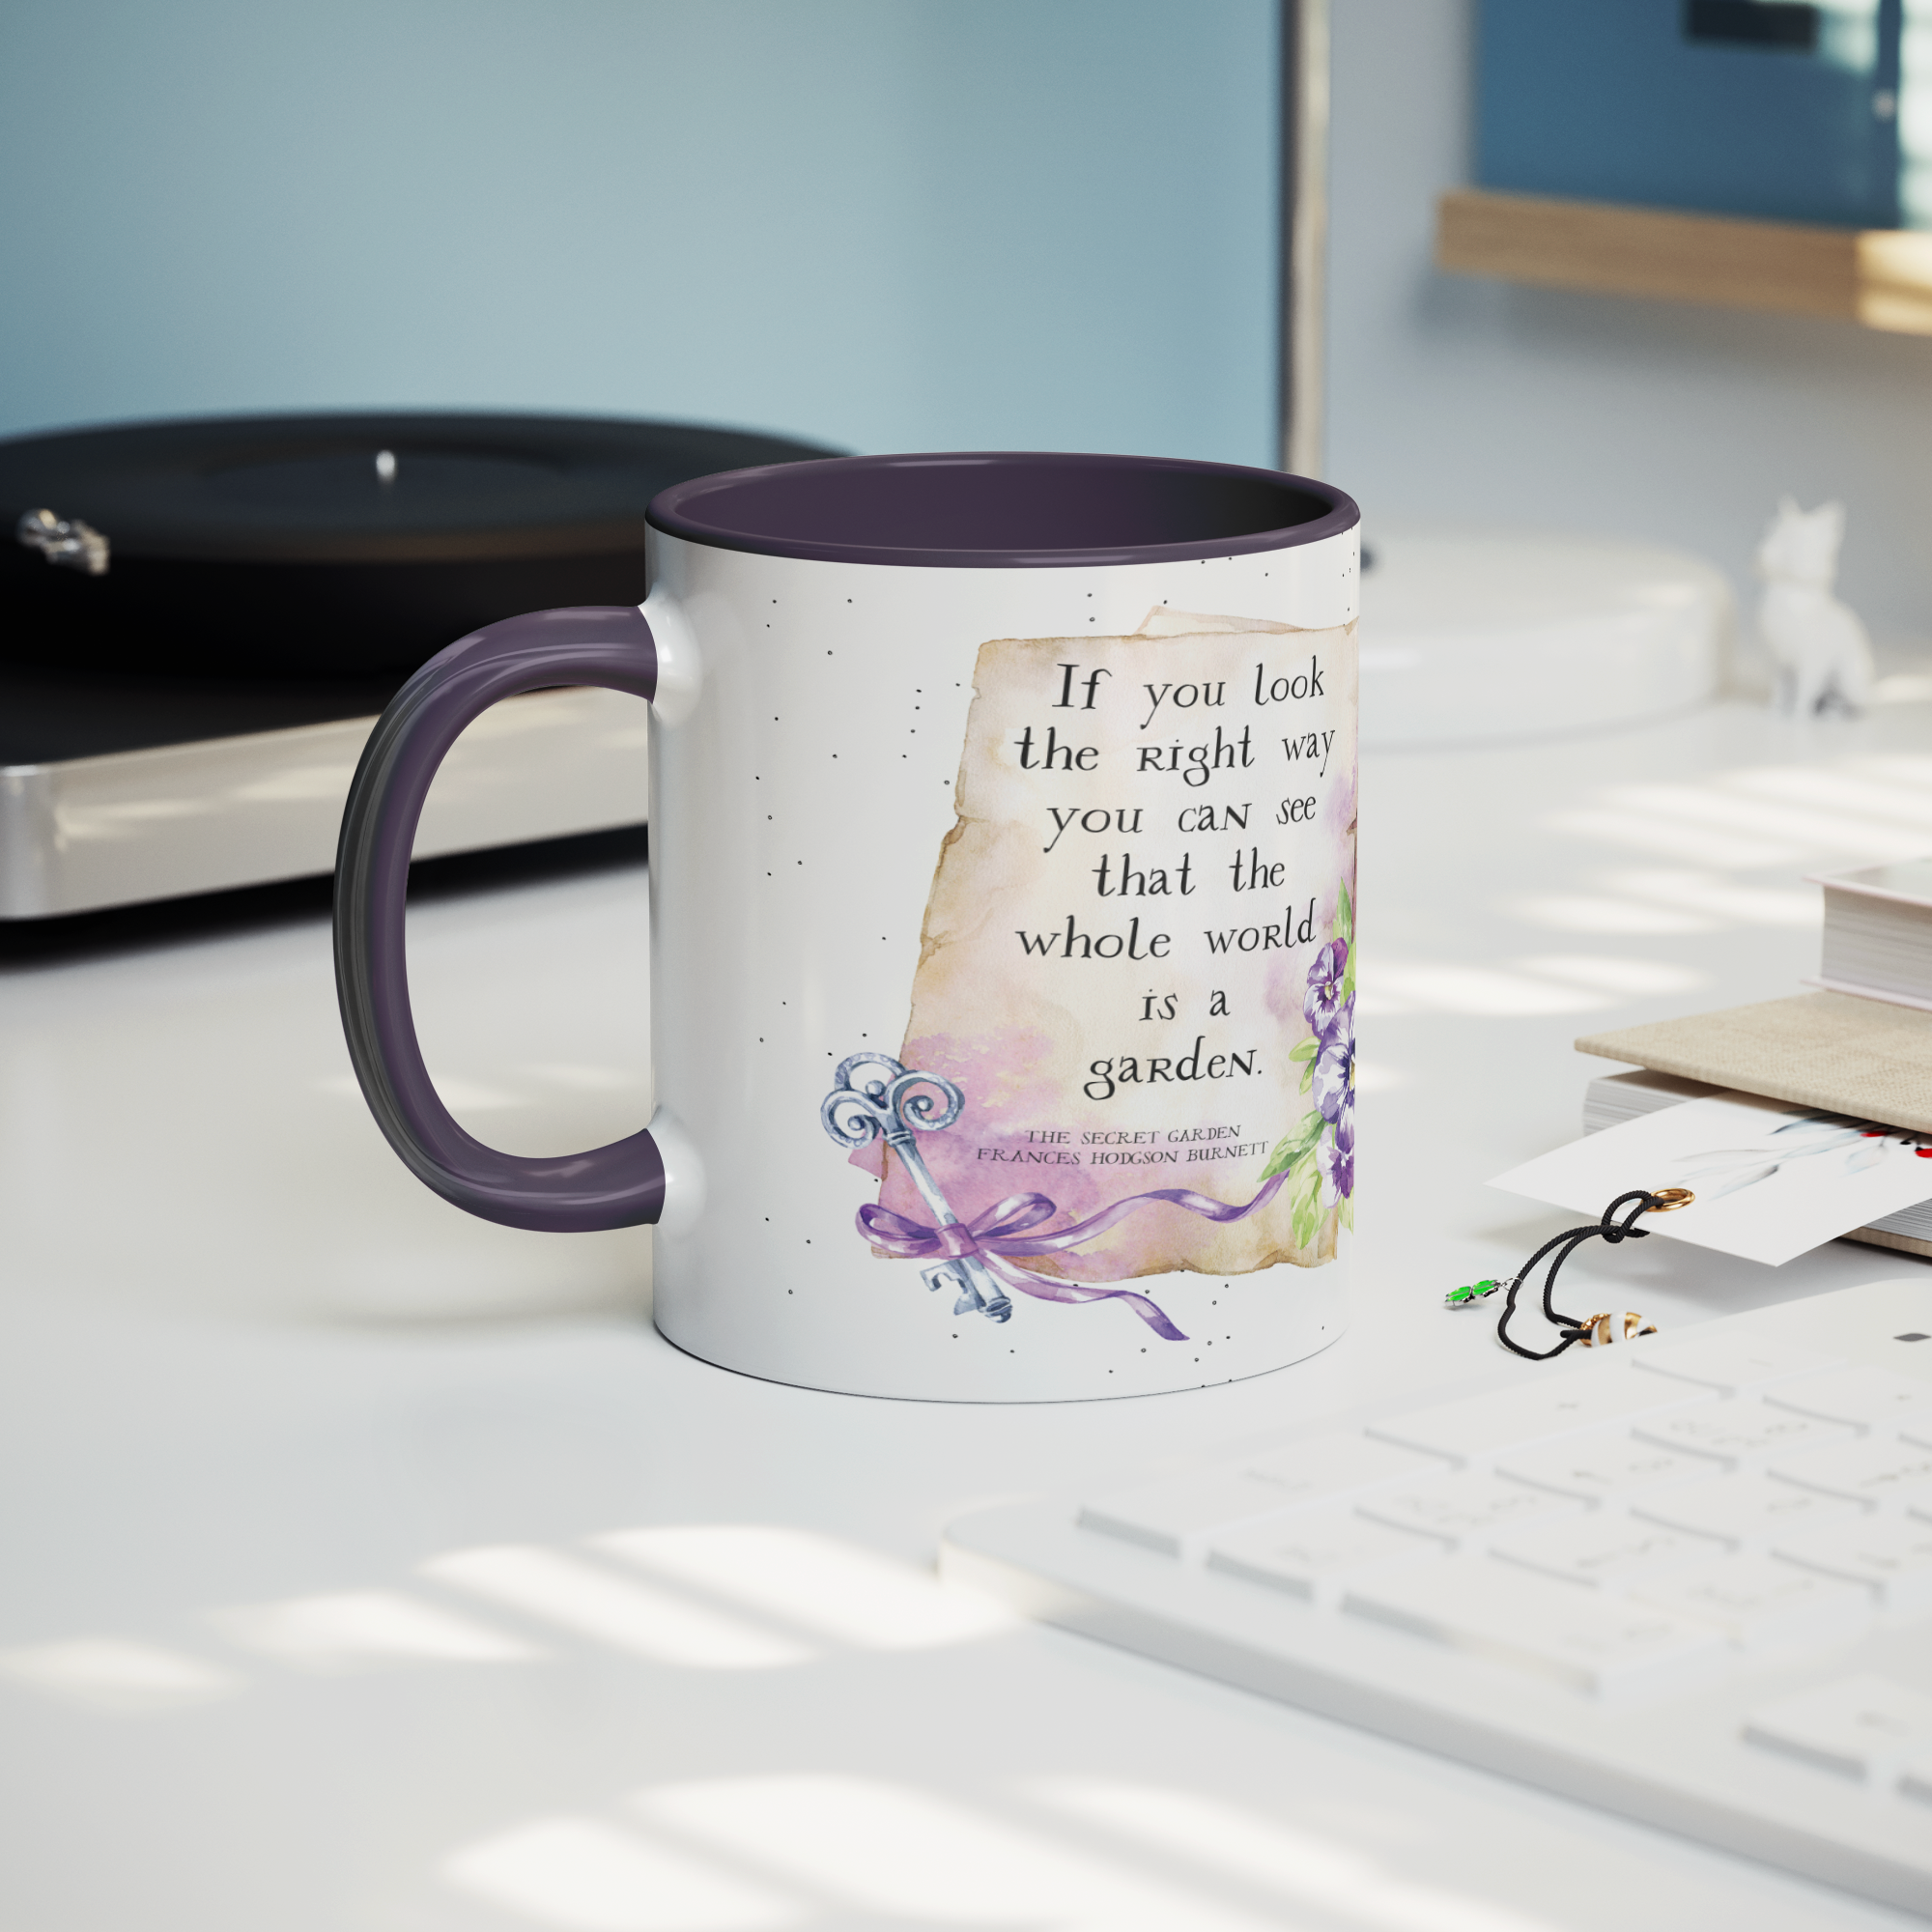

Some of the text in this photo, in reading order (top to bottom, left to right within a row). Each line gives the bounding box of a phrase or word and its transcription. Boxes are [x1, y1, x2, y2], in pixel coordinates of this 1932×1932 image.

[1051, 654, 1324, 730] If you look
[1013, 725, 1099, 772] the
[1281, 729, 1336, 779] way
[1042, 807, 1144, 857] you
[1275, 796, 1317, 825] see
[1091, 846, 1286, 897] that the
[1014, 914, 1172, 961] whole
[1138, 988, 1231, 1022] is a
[977, 1138, 1269, 1166] FRANCES HODGSON BURNETT
[1022, 1124, 1241, 1146] THE SECRET GARDEN
